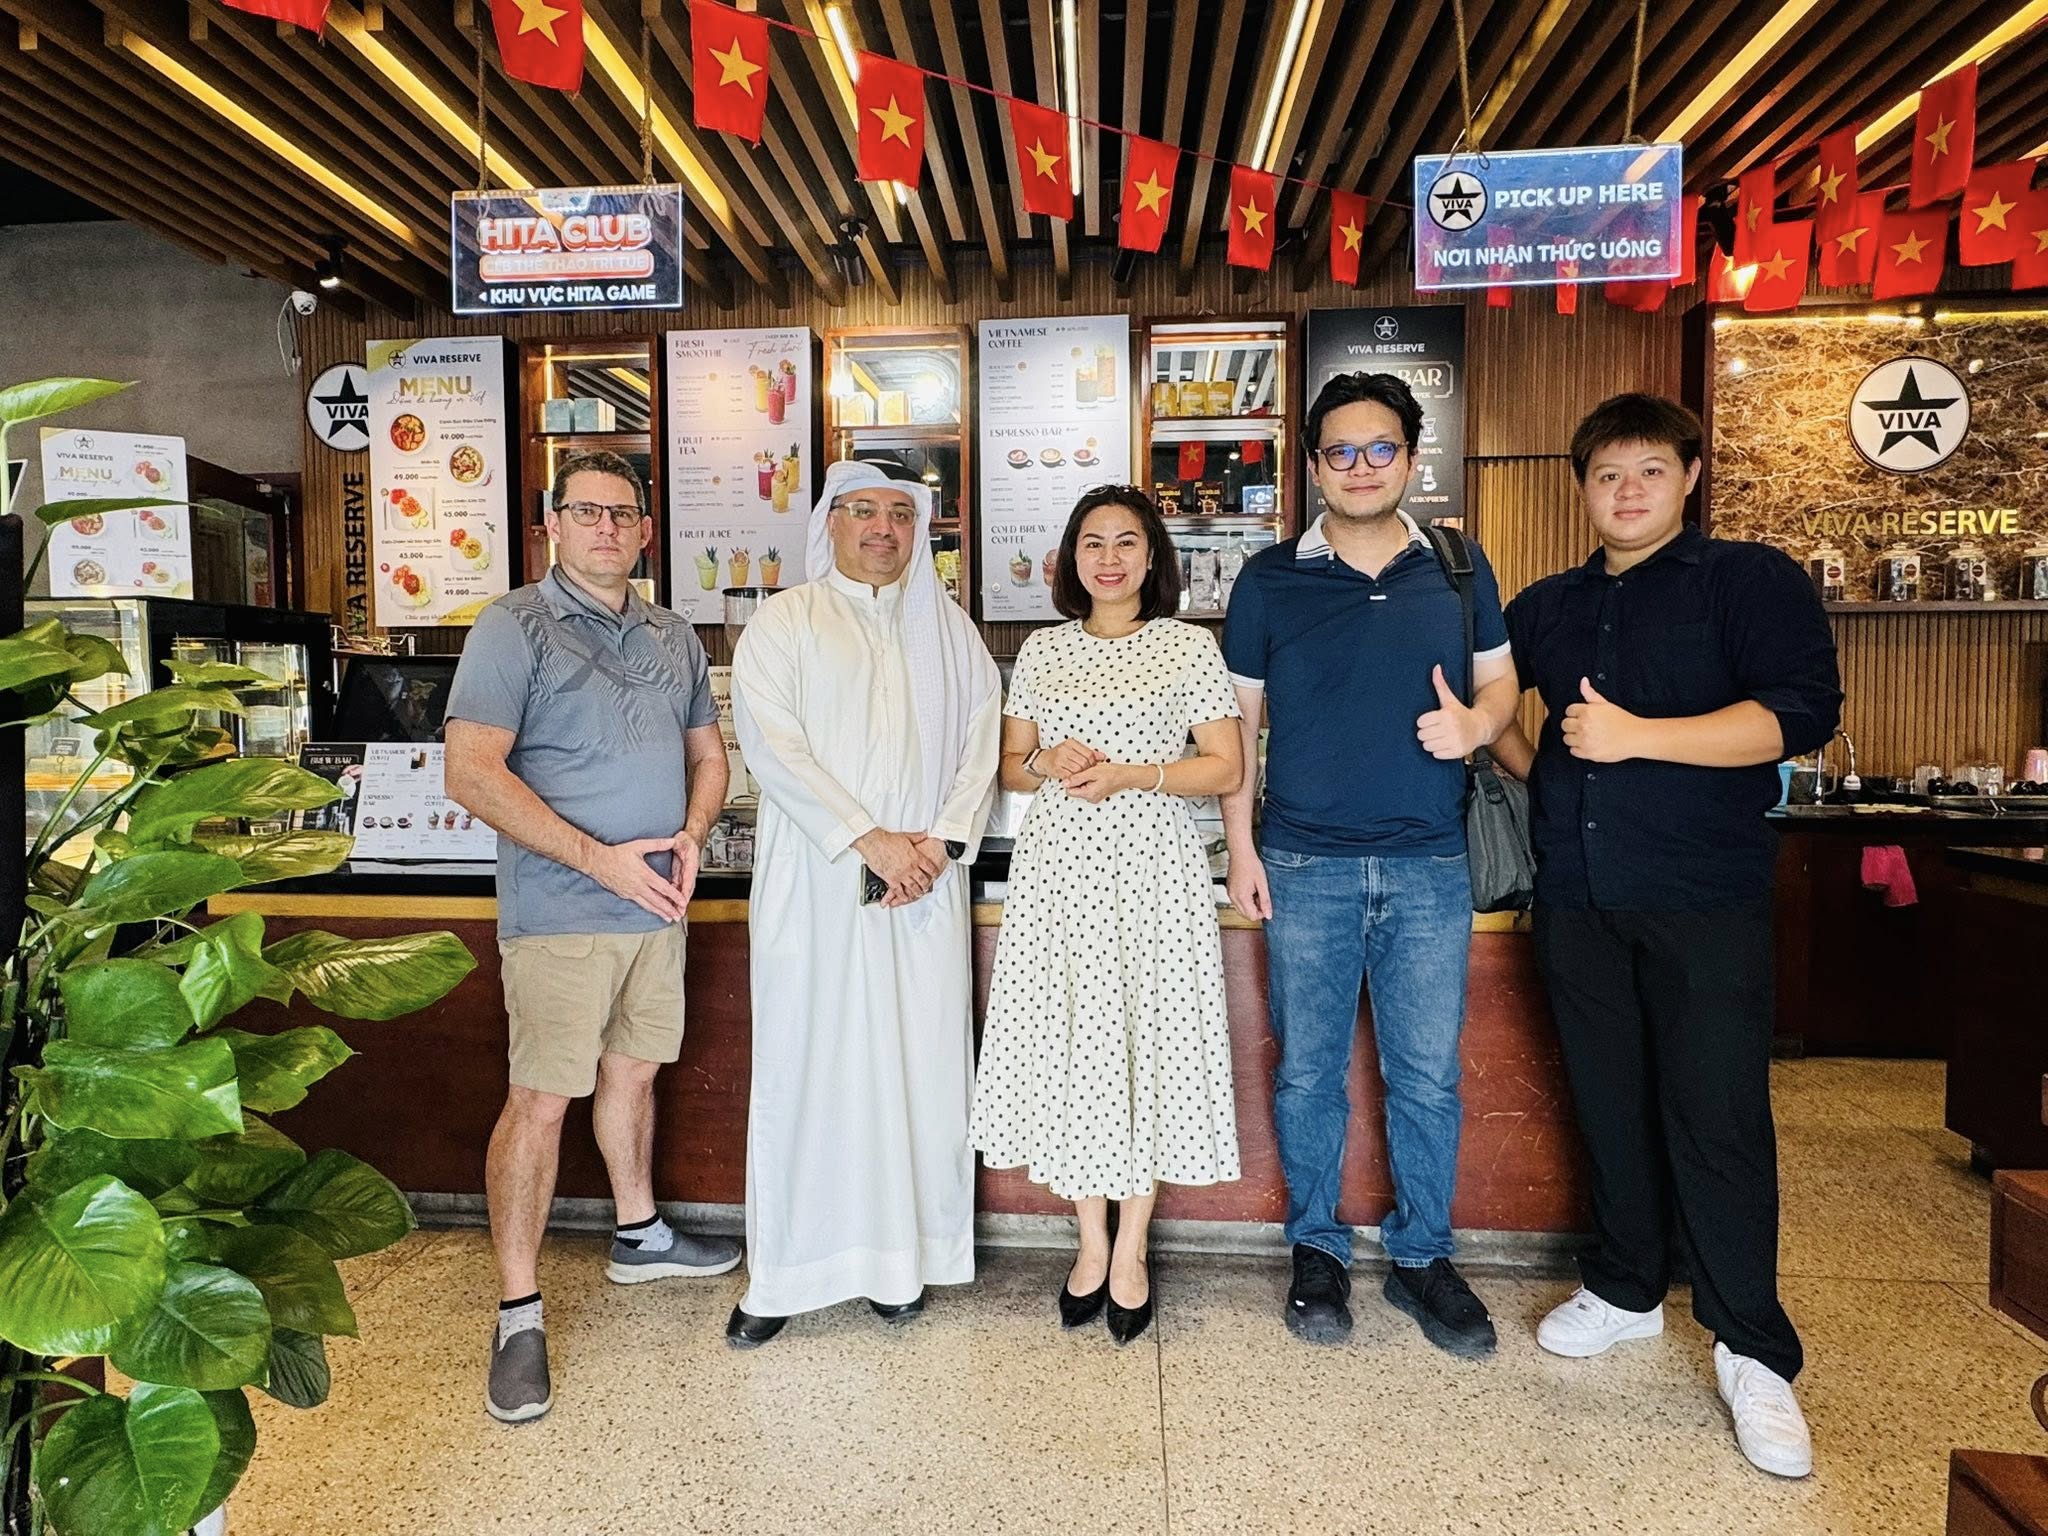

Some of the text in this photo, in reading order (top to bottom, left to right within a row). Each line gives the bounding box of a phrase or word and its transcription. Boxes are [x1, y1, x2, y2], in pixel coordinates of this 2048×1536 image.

[1494, 182, 1663, 209] PICK UP HERE
[1442, 201, 1474, 209] VIVA
[481, 214, 651, 251] HITA CLUB
[1434, 237, 1662, 267] NƠI NHẬN THỨC UỐNG
[490, 284, 656, 306] KHU VỰC HITA GAME
[988, 327, 1048, 338] VIETNAMESE
[988, 339, 1024, 349] COFFEE
[1347, 343, 1425, 354] VIVA RESERVE
[413, 354, 482, 364] VIVA RESERVE
[1398, 368, 1442, 387] BAR
[399, 376, 472, 396] MENU
[326, 405, 368, 418] VIVA
[1878, 411, 1942, 429] VIVA
[990, 427, 1062, 438] ESPRESSO BAR
[679, 447, 697, 455] TEA
[60, 466, 112, 480] MENU
[343, 471, 367, 587] RESERVE
[991, 524, 1048, 534] COLD BREW
[1801, 509, 2018, 536] VIVA RESERVE
[679, 530, 732, 538] FRUIT JUICE
[991, 536, 1026, 544] COFFEE
